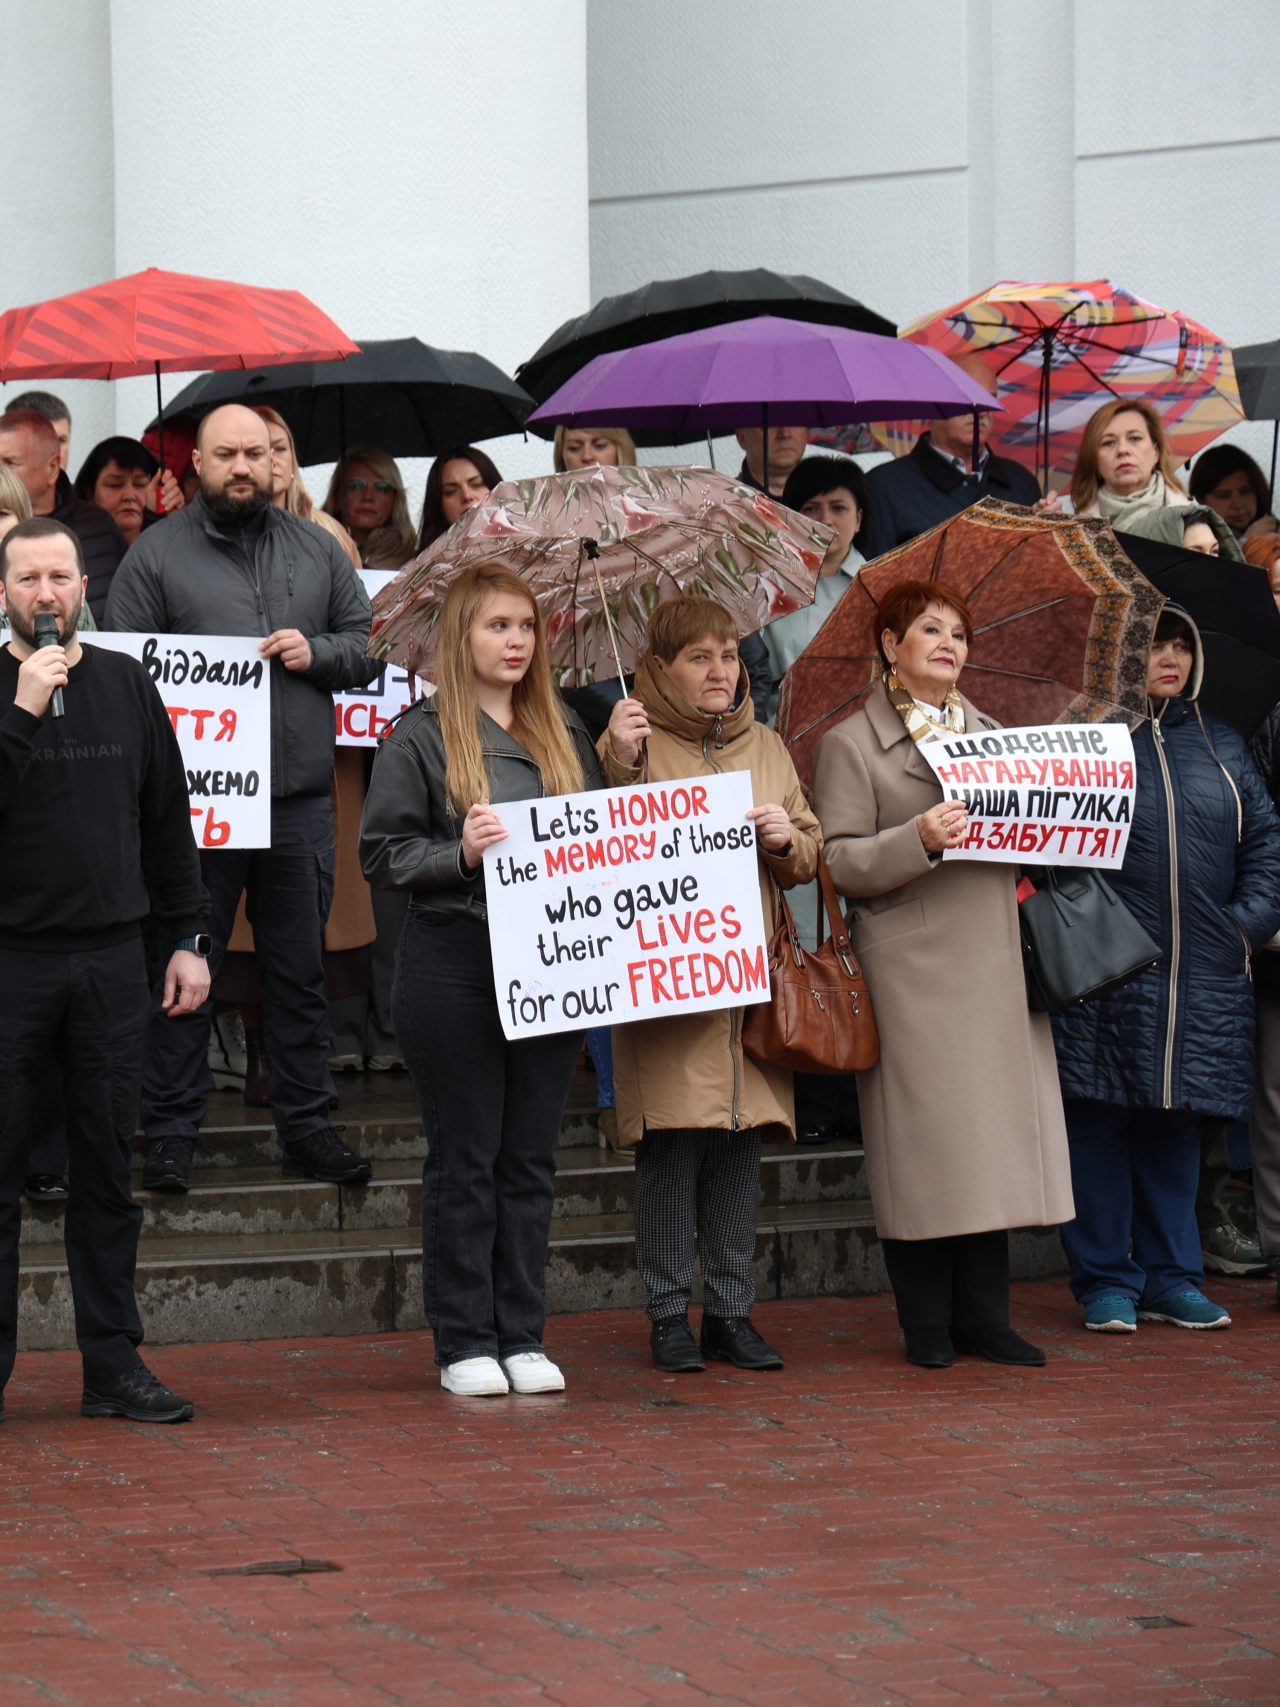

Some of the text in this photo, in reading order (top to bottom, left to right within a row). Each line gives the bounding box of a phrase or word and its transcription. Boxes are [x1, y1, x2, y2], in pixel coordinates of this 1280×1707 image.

[937, 759, 1134, 789] НАГАДУВАННЯ
[530, 785, 710, 842] Let's HONOR
[496, 855, 538, 886] the
[661, 827, 682, 859] of
[689, 823, 754, 855] those
[545, 875, 699, 930] who gave
[537, 931, 613, 967] their
[507, 945, 767, 1026] for our FREEDOM
